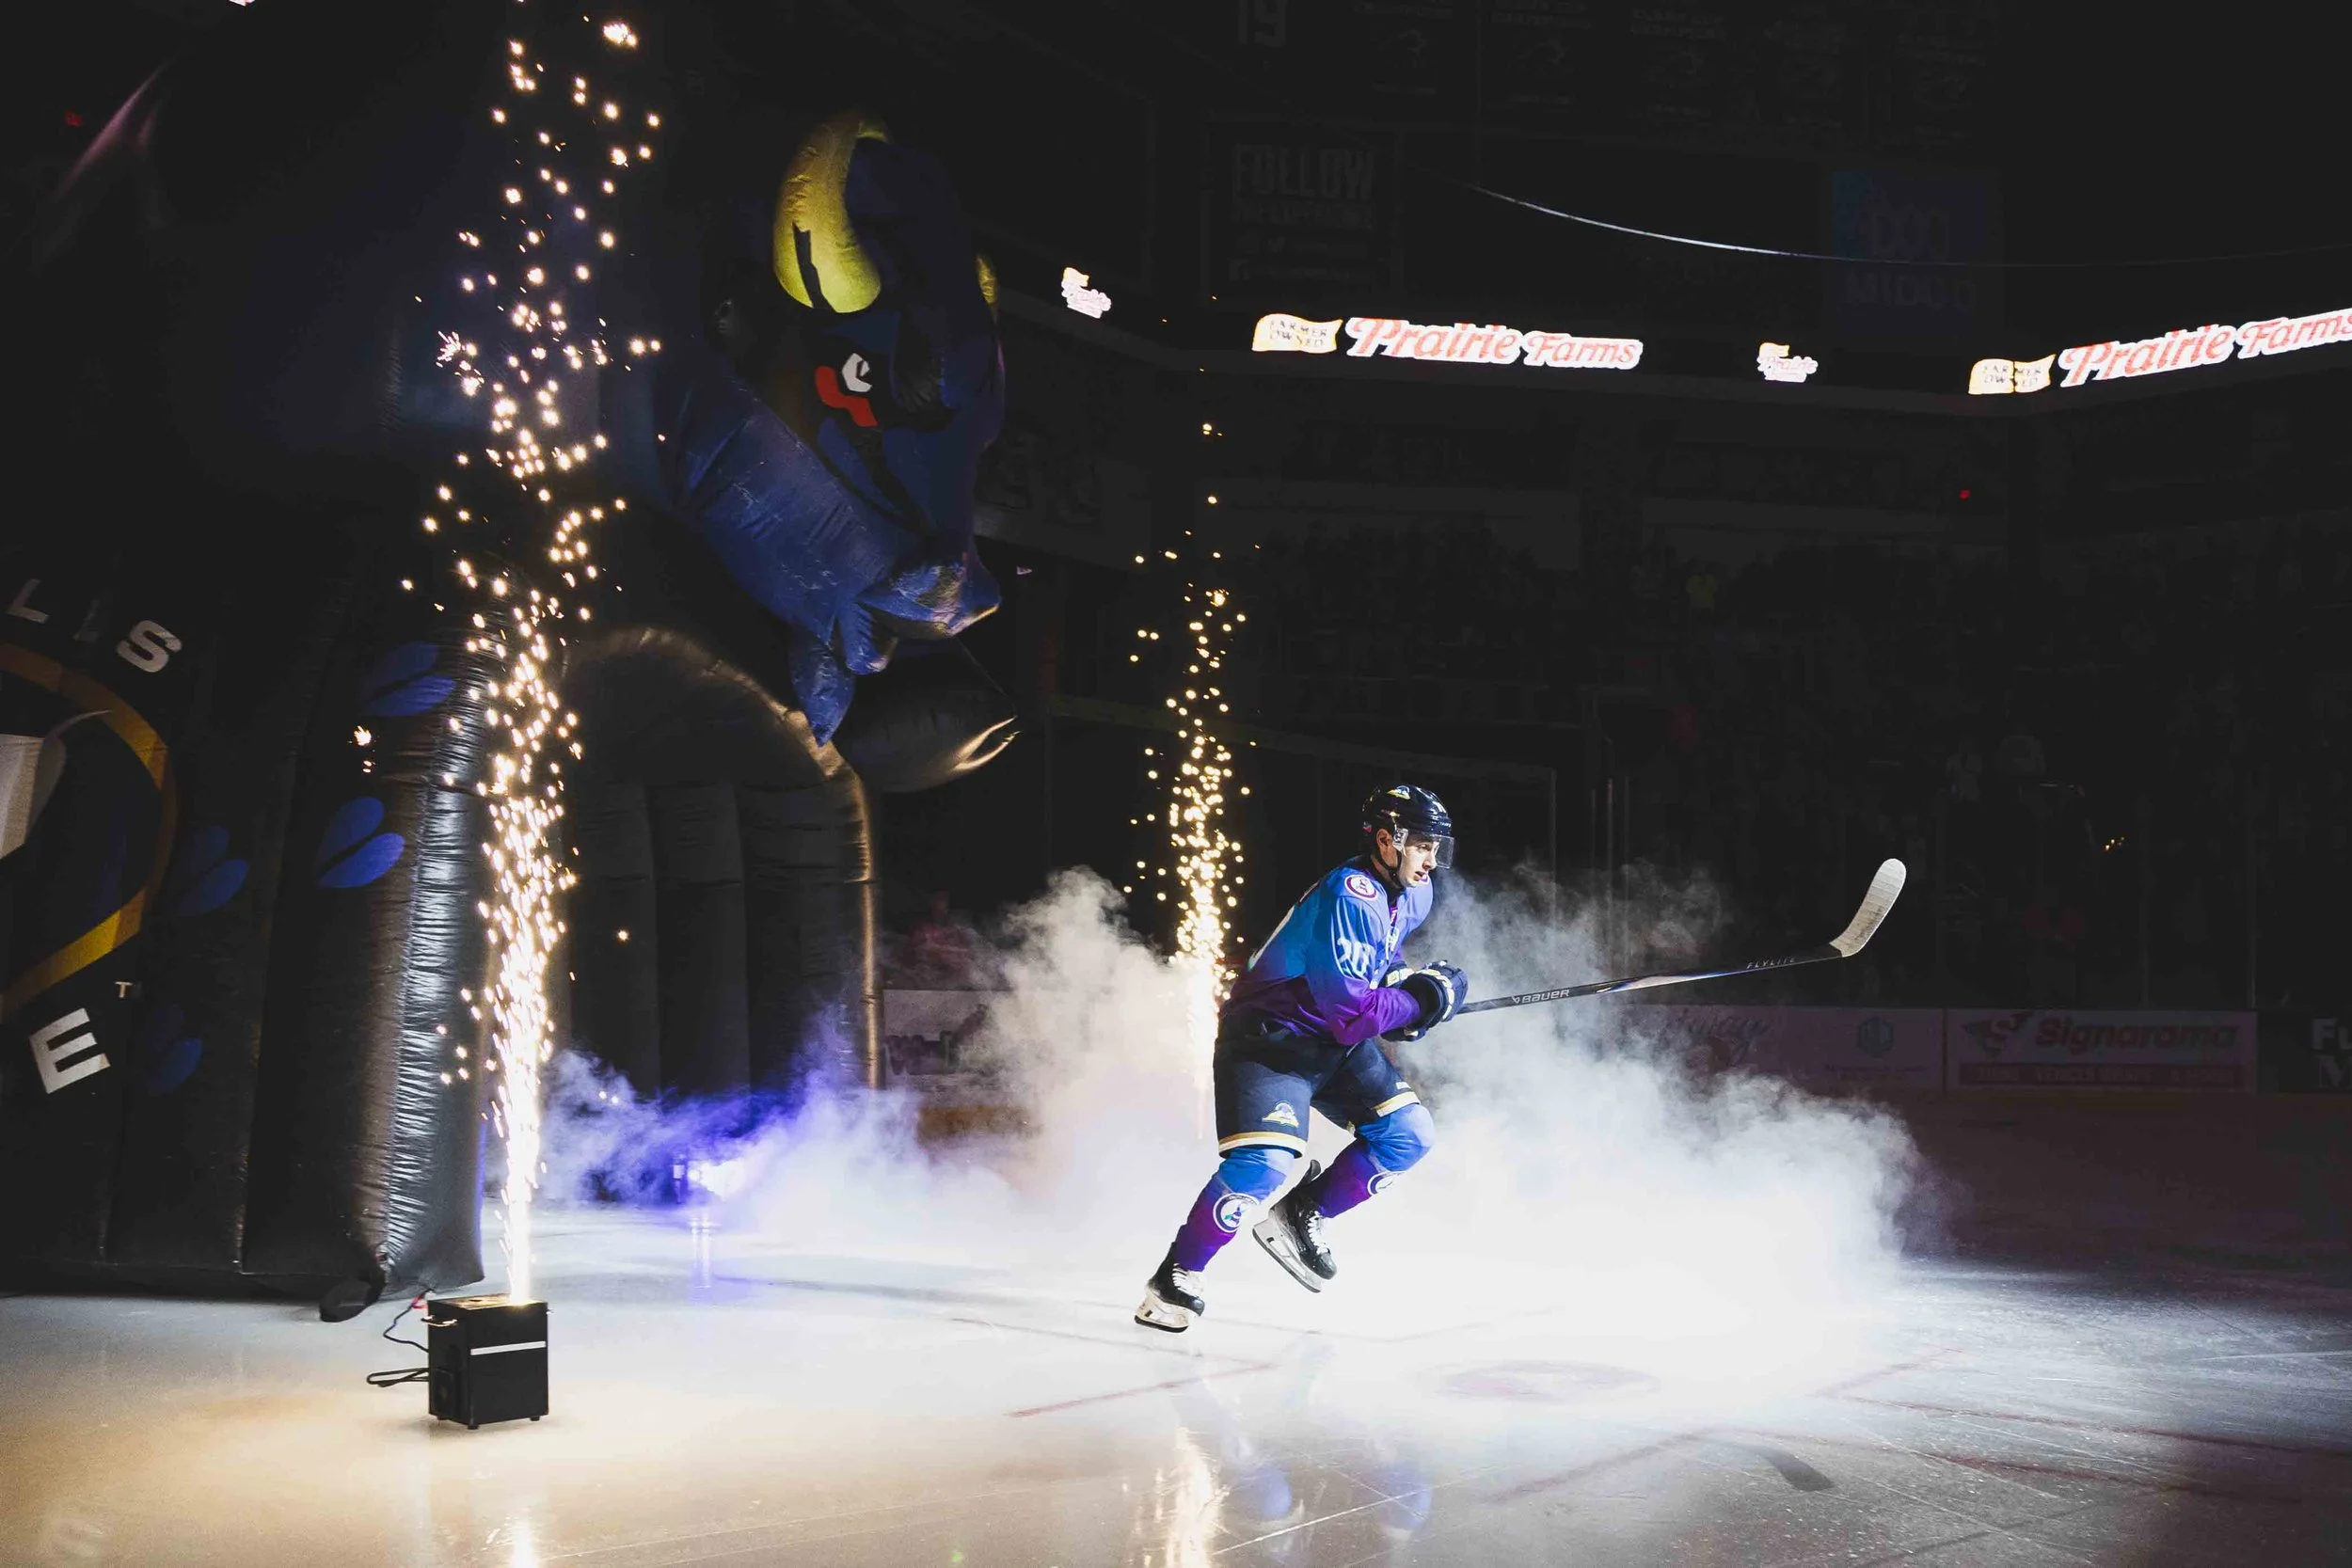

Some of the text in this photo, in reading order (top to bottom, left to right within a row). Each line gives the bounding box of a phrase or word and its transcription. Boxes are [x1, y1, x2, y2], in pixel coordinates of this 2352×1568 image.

[1233, 142, 1375, 200] FOLLOW
[1353, 317, 1637, 364] Prairie Farms
[2064, 325, 2231, 384] Prairie
[2036, 1017, 2240, 1055] Signarama
